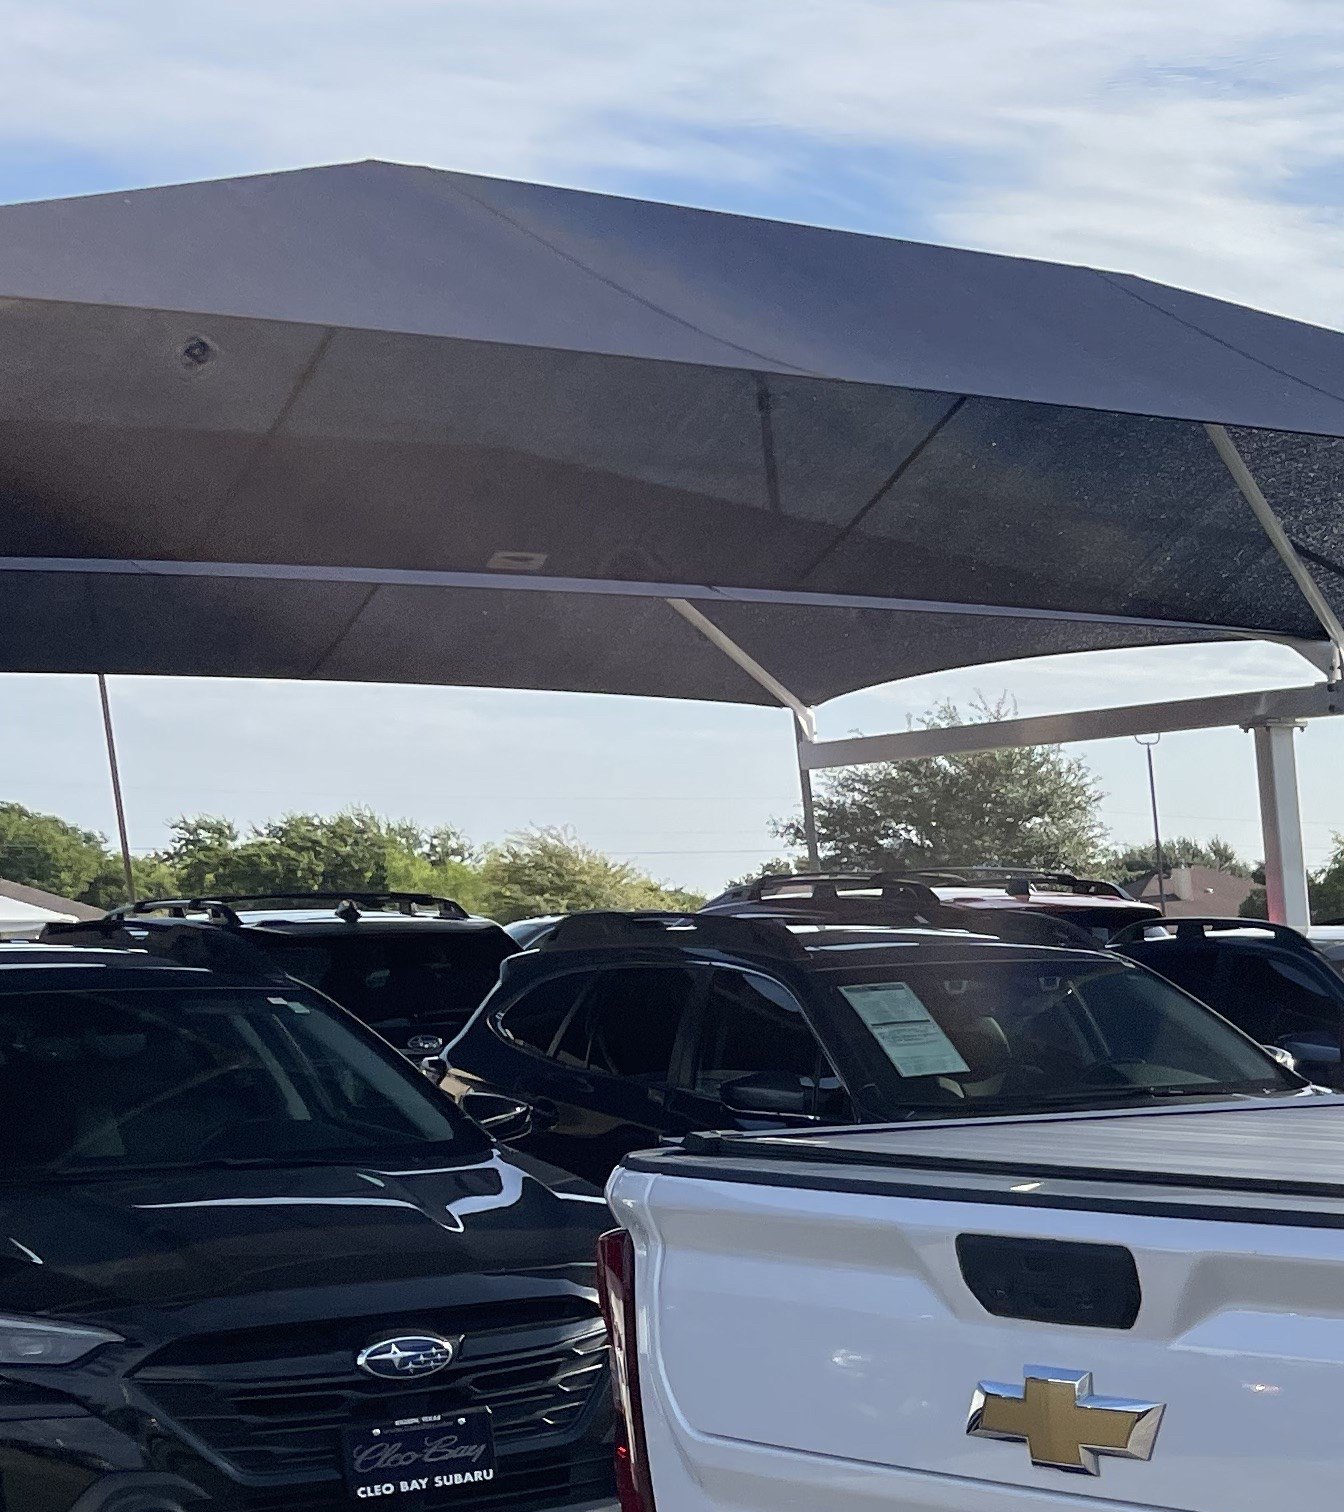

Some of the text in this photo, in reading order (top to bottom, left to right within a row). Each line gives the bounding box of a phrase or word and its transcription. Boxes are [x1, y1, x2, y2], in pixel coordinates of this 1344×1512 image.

[353, 1435, 487, 1473] Cleo Bay
[356, 1468, 494, 1498] CLEO BAY SUBARU
